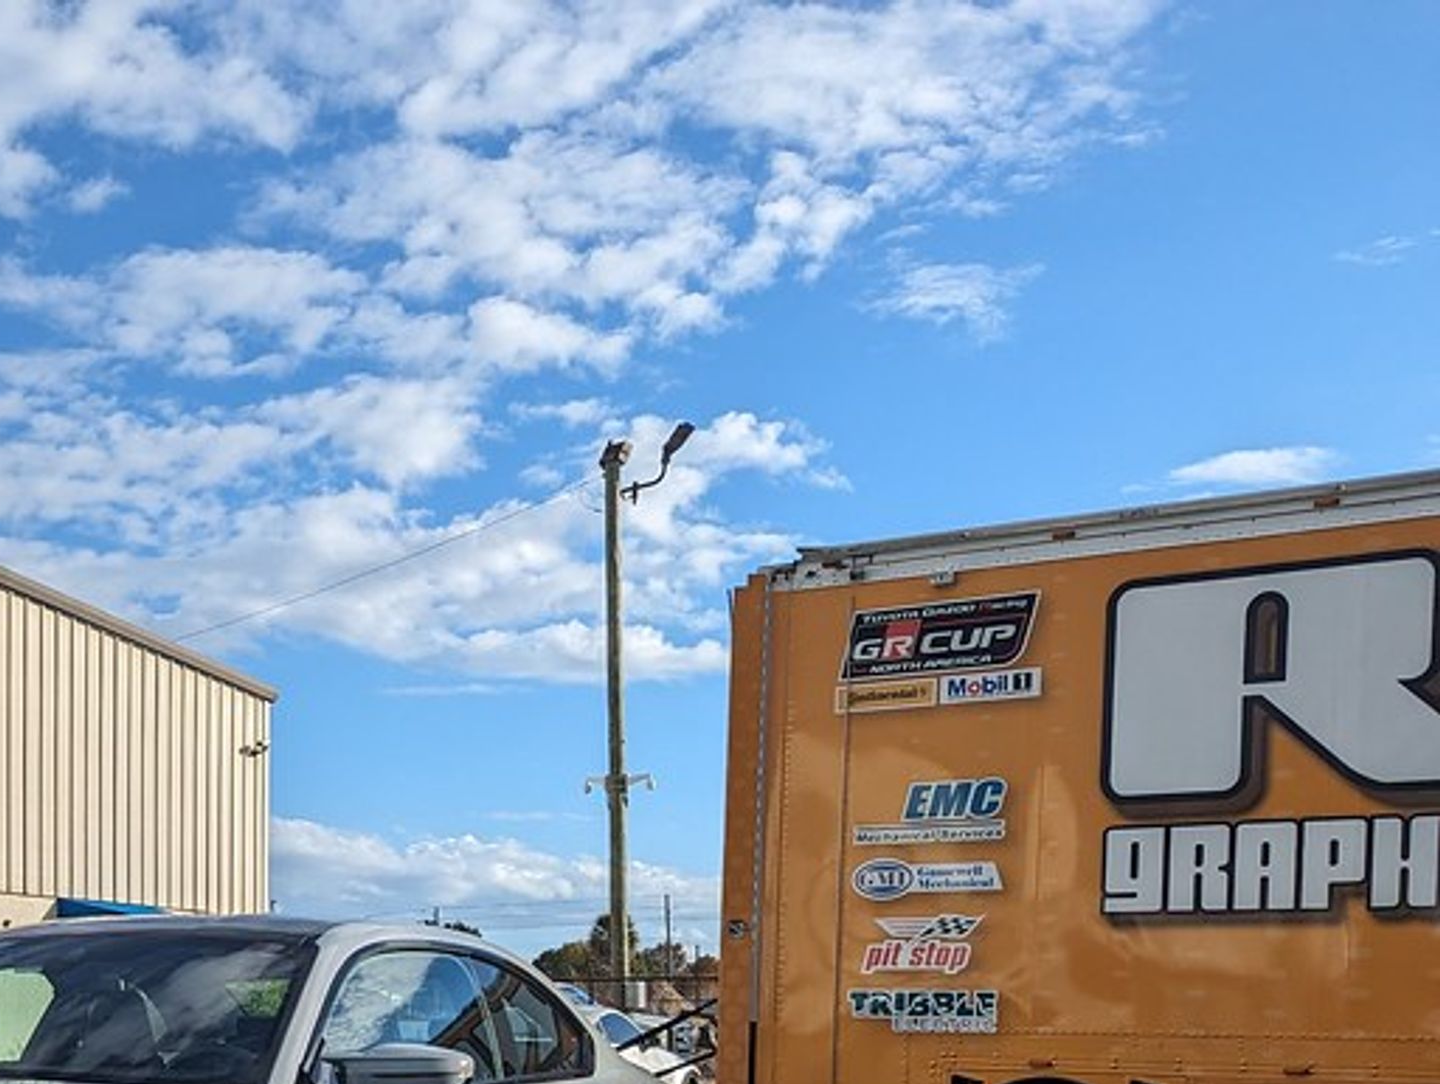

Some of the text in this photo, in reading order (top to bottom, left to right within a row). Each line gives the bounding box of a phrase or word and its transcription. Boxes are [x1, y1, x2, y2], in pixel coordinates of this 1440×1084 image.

[920, 624, 1016, 653] CUP
[869, 655, 993, 674] NORTH AMERICA
[948, 674, 1008, 697] Mobil
[905, 780, 1005, 819] EMC
[865, 941, 968, 971] pit stop
[850, 992, 995, 1017] TRIBBLE
